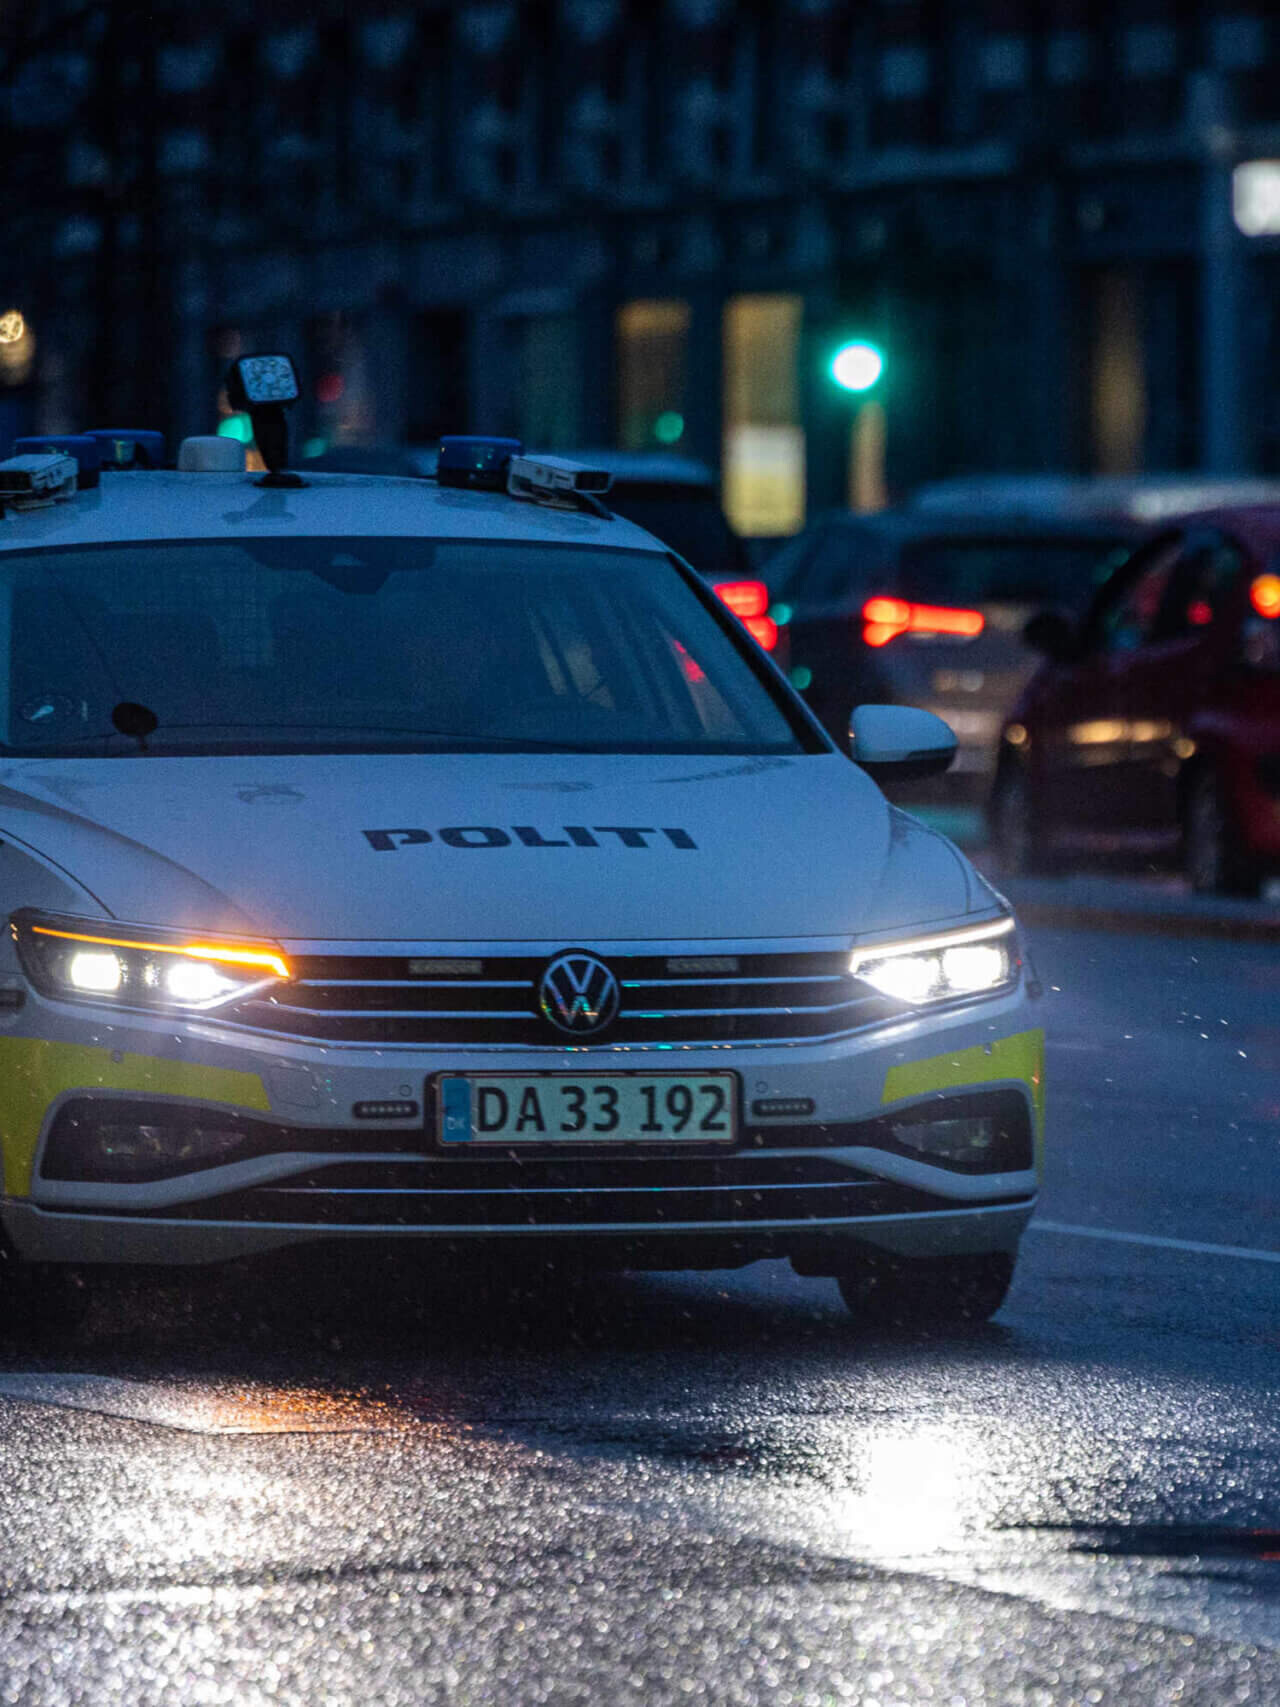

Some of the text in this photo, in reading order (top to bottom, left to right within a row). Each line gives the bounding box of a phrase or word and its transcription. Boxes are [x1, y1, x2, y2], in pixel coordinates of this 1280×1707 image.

[362, 826, 699, 850] POLITI
[477, 1085, 726, 1132] DA 33 192
